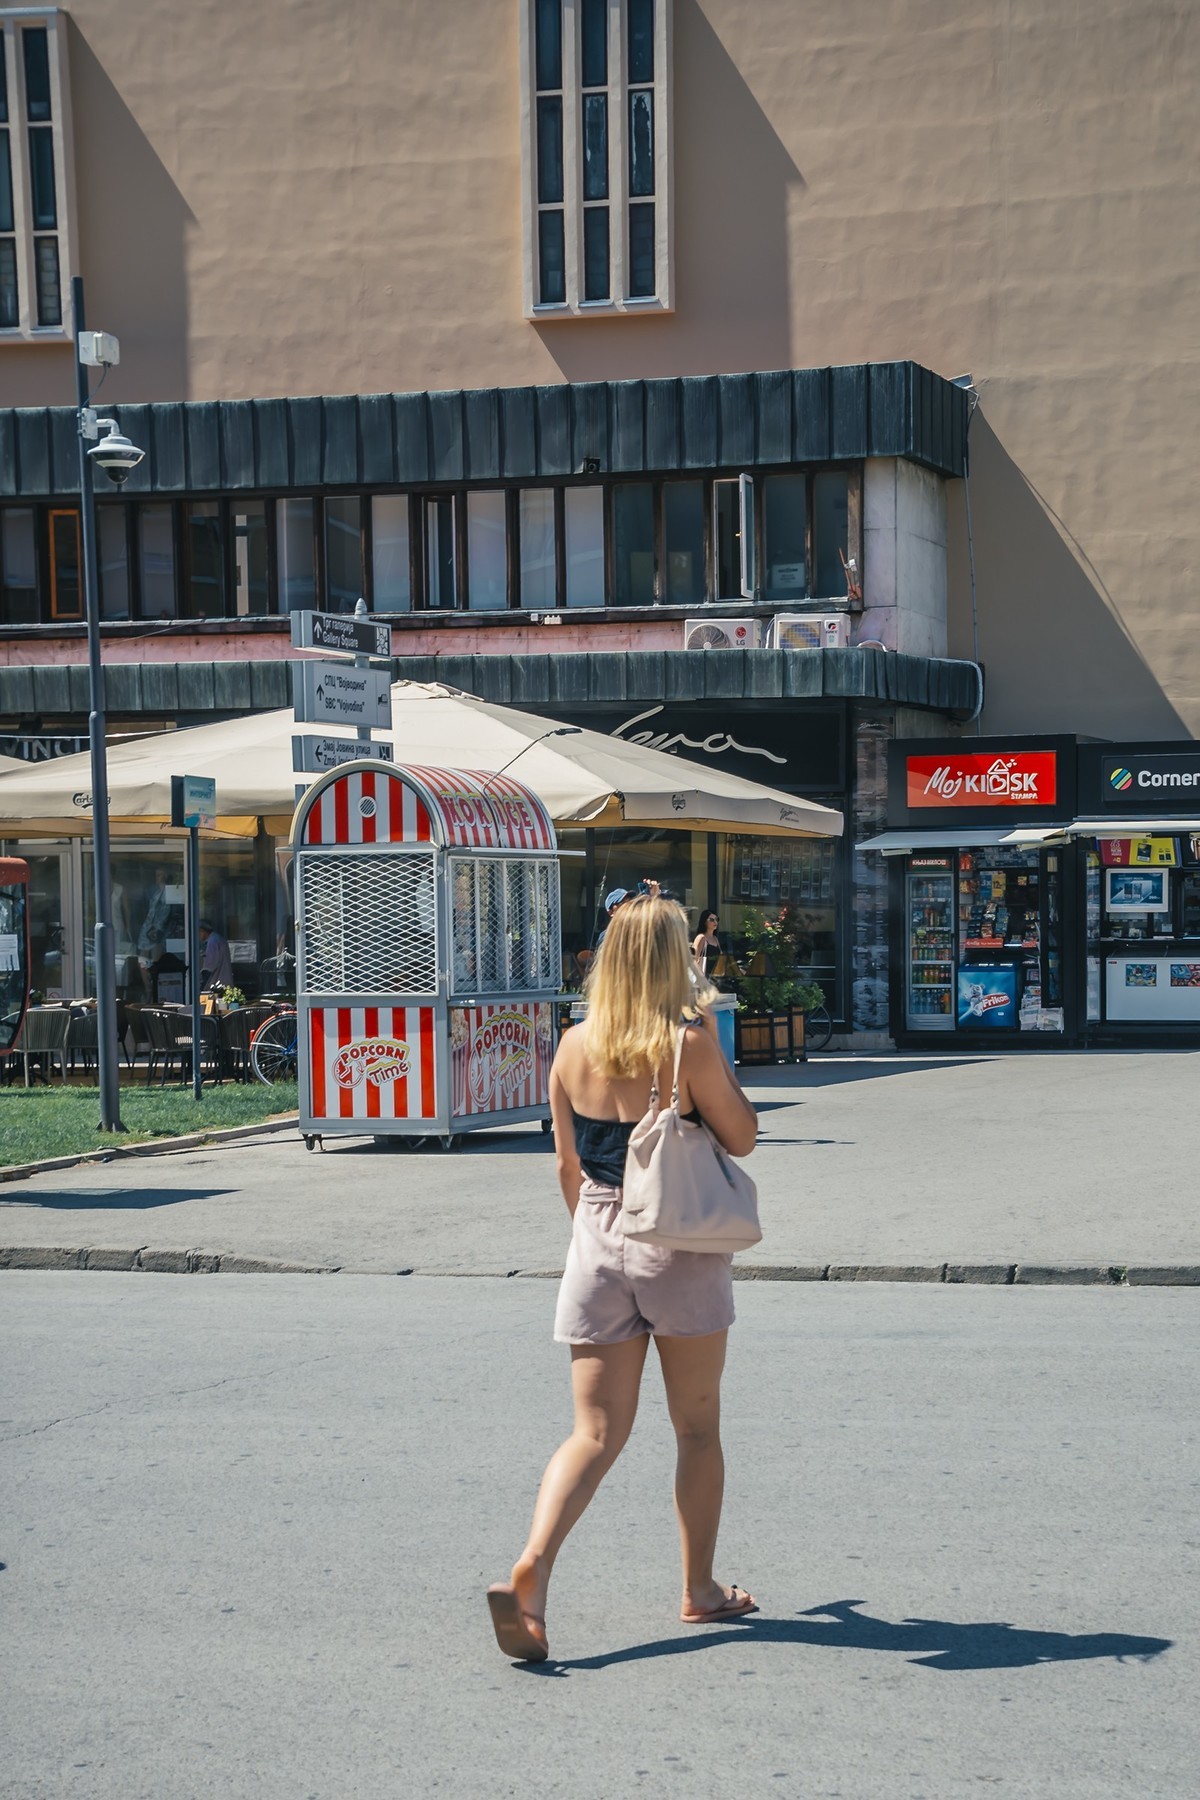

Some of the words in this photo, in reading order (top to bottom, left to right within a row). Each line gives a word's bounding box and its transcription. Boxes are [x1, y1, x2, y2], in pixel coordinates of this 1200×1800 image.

[322, 630, 340, 648] Gallery
[341, 633, 359, 649] Square
[324, 674, 337, 689] СПЦ
[337, 698, 365, 714] "Vojvodina"
[323, 739, 336, 755] Змај
[336, 741, 355, 754] Јовина
[323, 754, 336, 767] Zmaj
[923, 766, 963, 799] Moj
[1137, 770, 1200, 788] Corner
[475, 1020, 531, 1060] POPCORN
[339, 1043, 407, 1065] POPCORN
[368, 1061, 409, 1084] Time
[499, 1051, 533, 1099] Time
